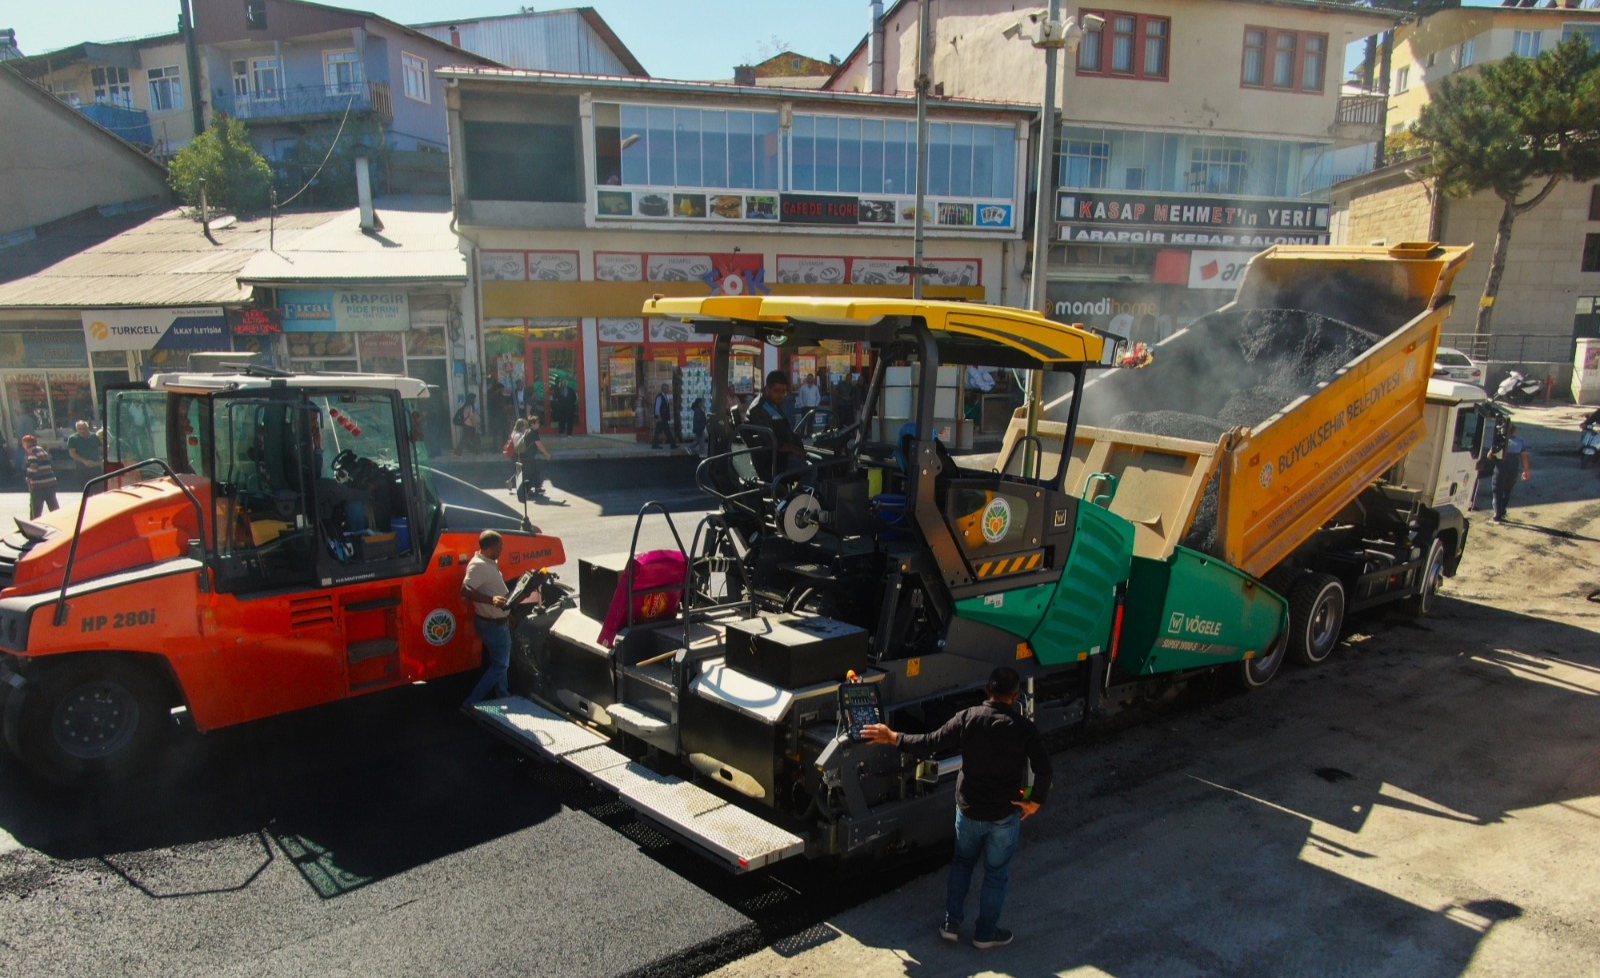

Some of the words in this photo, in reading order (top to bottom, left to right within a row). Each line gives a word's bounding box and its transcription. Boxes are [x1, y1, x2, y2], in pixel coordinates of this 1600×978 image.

[782, 201, 807, 216] CAFE
[809, 202, 823, 216] DE
[827, 203, 858, 218] FLORE
[1079, 200, 1145, 220] KASAP
[1267, 206, 1311, 227] YERİ
[1075, 230, 1165, 243] ARAPGİR
[1170, 232, 1235, 245] KEBAP
[1240, 235, 1314, 246] SALONU
[340, 292, 404, 304] ARAPGİR
[346, 304, 369, 314] PİDE
[370, 305, 399, 314] FIRINI
[110, 325, 162, 336] TURKCELL
[173, 326, 192, 335] İLKAY
[194, 325, 222, 336] İLETİŞİM
[1278, 410, 1346, 475] BÜYÜKŞEHİR
[1346, 369, 1401, 422] BELEDİYESİ
[522, 549, 552, 560] HAMM
[81, 614, 108, 633] HP
[113, 608, 156, 629] 280i
[1185, 615, 1222, 636] VÖGELE
[1161, 638, 1179, 649] SUPER
